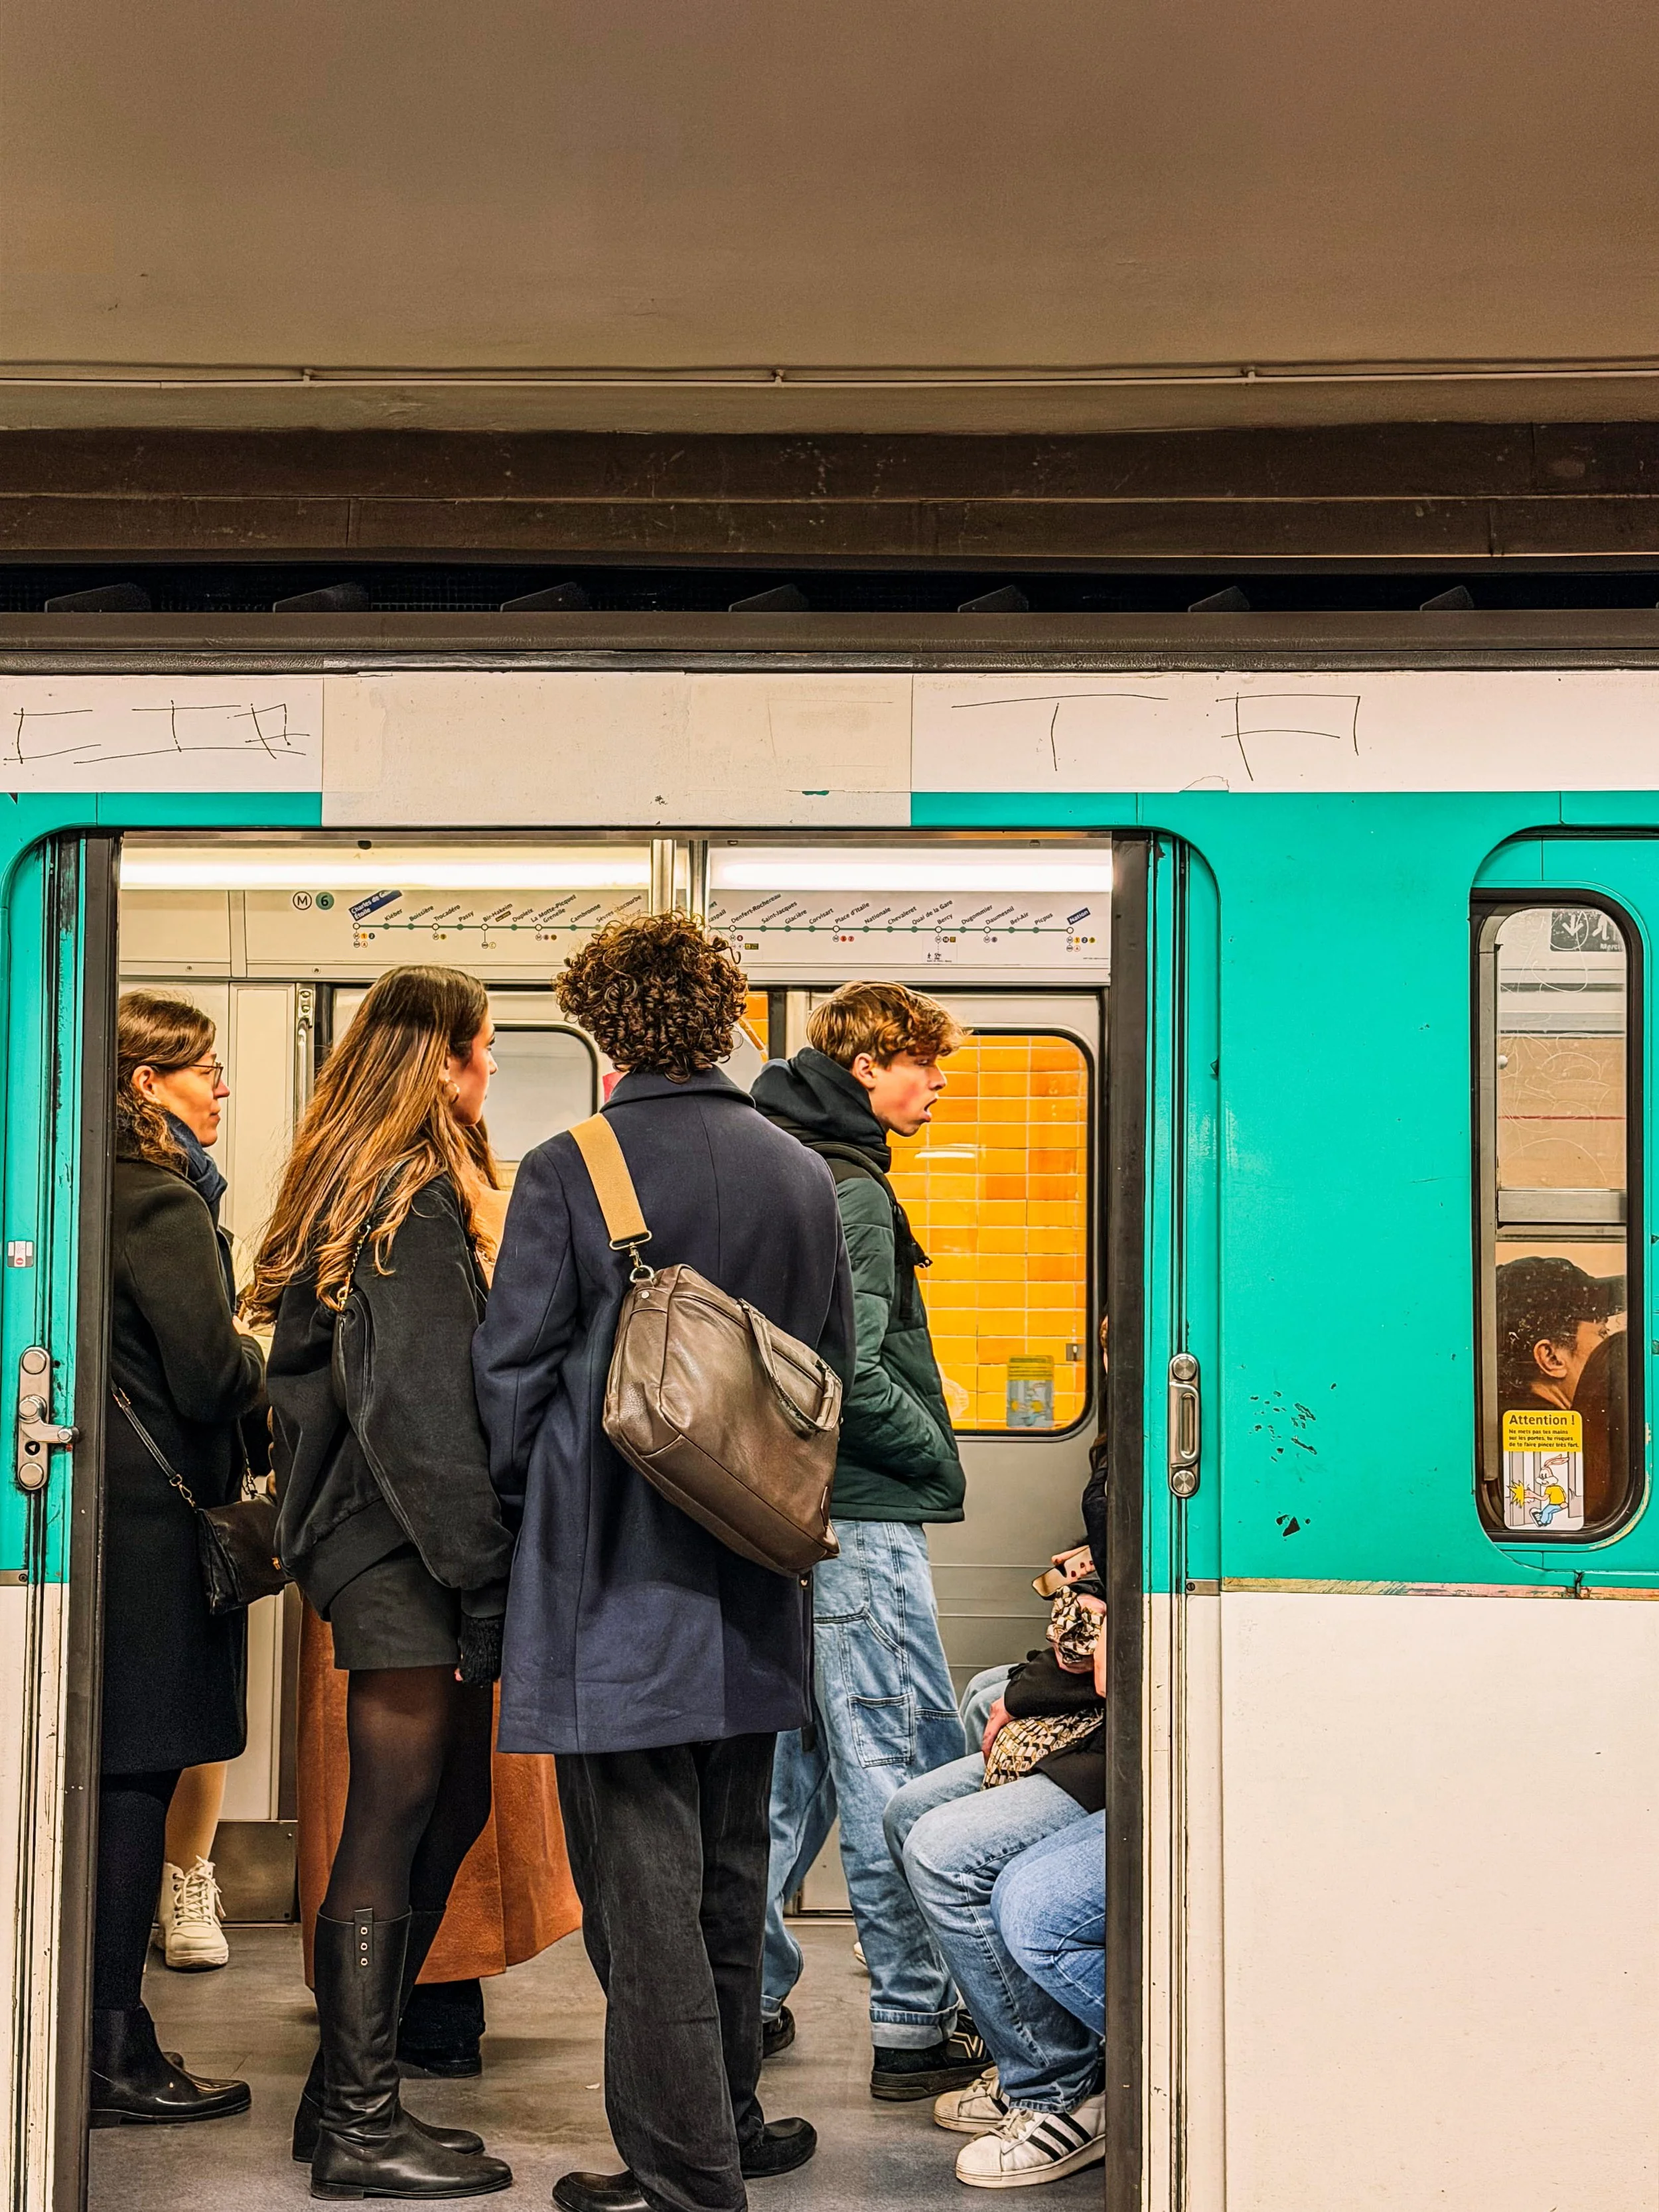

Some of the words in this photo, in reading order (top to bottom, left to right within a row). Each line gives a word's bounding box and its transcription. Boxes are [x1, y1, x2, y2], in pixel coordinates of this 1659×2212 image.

[351, 900, 372, 914] Charles
[354, 908, 371, 920] Étoile
[409, 905, 434, 922] Boissière
[433, 904, 461, 922] Trocadéro
[482, 903, 513, 922] Bir-Hakeim
[538, 894, 577, 919] Motte-Picquet
[570, 903, 601, 923] Cambronne
[731, 894, 781, 924] Denfert-Rochereau
[761, 901, 798, 924] Saint-Jacques
[912, 916, 925, 926] Quai
[939, 900, 953, 910] Gare
[384, 909, 403, 921] Kléber
[458, 911, 474, 922] Passy
[512, 908, 534, 922] Dupleix
[543, 908, 565, 923] Grenelle
[708, 909, 727, 923] aspail
[784, 909, 808, 924] Glacière
[808, 908, 834, 925] Corvisart
[835, 915, 850, 924] Place
[864, 907, 891, 925] Nationale
[887, 906, 917, 925] Chevaleret
[936, 914, 953, 925] Bercy
[961, 904, 993, 926] Dugommier
[985, 906, 1015, 926] Daumesnil
[1010, 912, 1029, 926] Bel-Air
[1034, 912, 1054, 926] Picpus
[1068, 910, 1088, 924] Nation
[1509, 1415, 1567, 1425] Attention
[1571, 1415, 1575, 1425] !
